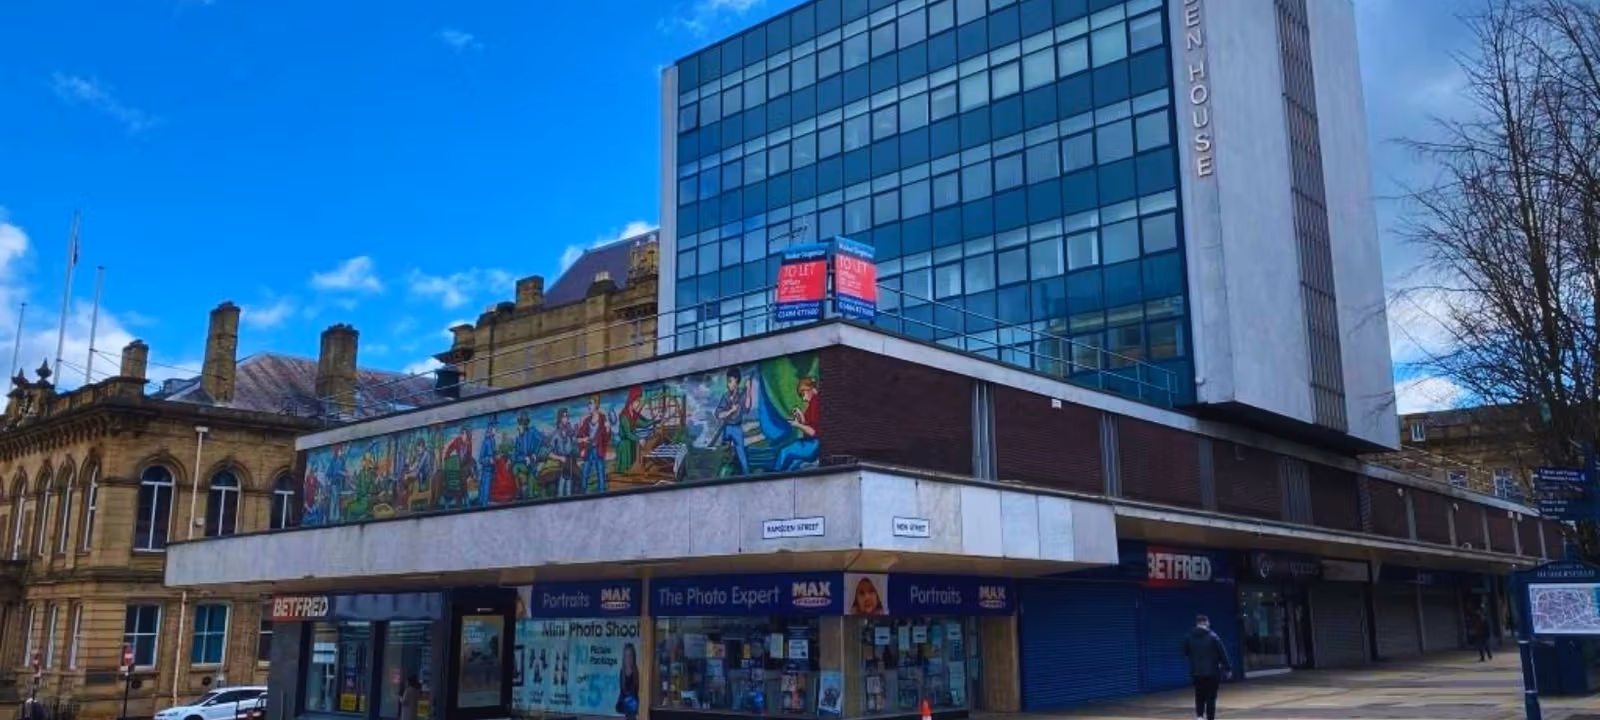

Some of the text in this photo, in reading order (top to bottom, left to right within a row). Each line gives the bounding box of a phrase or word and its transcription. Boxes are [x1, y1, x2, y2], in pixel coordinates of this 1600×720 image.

[1184, 0, 1213, 177] EN HOUSE
[799, 263, 816, 276] LET
[839, 257, 867, 273] TO LET
[766, 522, 819, 533] RAMSDEN STREET
[1147, 553, 1212, 581] BETFRED
[601, 588, 631, 601] MAX
[658, 588, 683, 606] The
[687, 586, 728, 605] Photo
[732, 585, 781, 607] Expert
[792, 581, 831, 597] MAX
[910, 585, 962, 604] Portraits
[978, 586, 1006, 599] MAX
[273, 596, 328, 617] BETFRED
[543, 591, 590, 609] Portraits
[542, 621, 640, 637] Mini Photo Shoot
